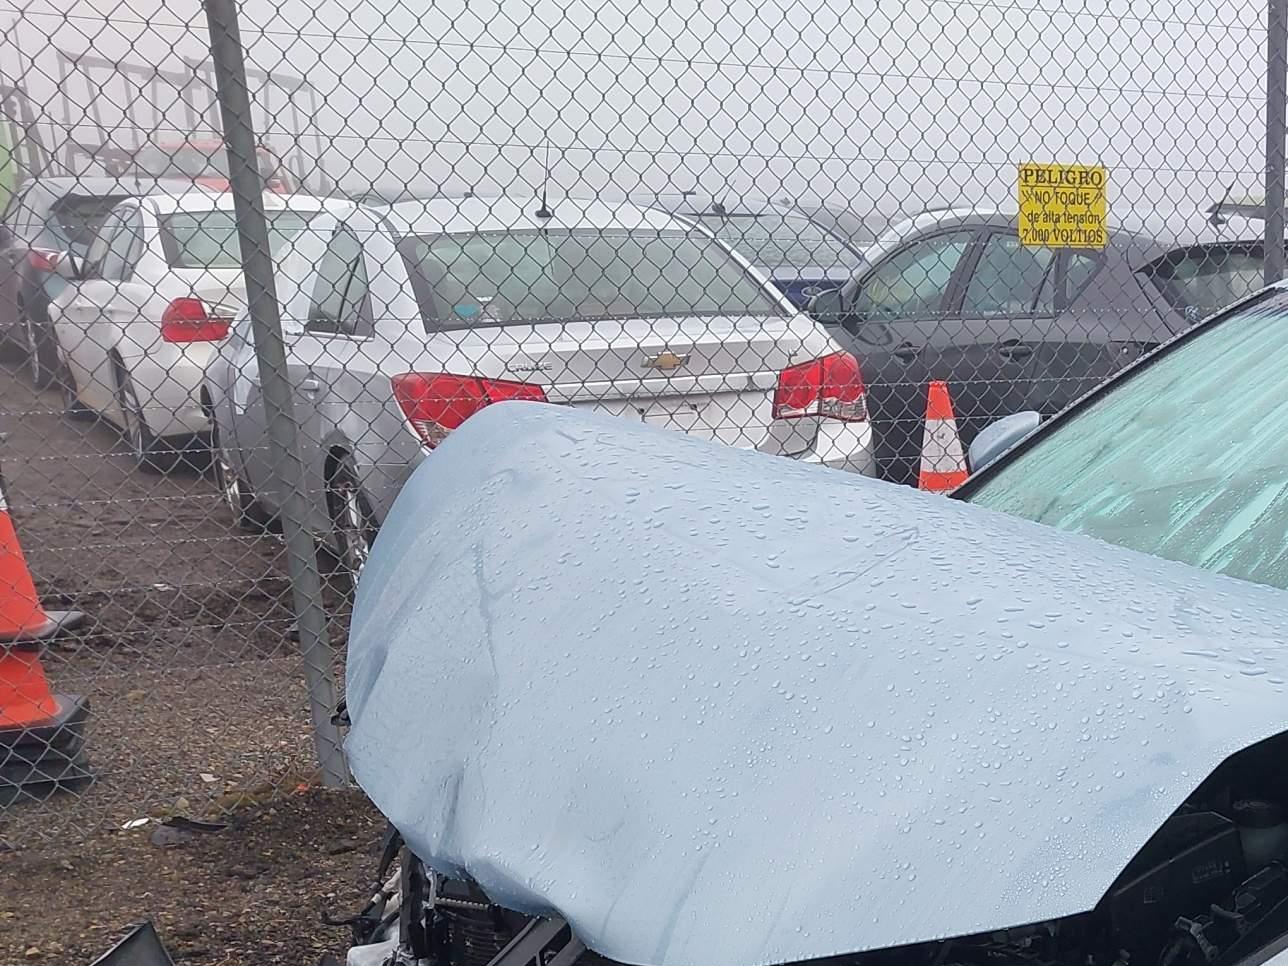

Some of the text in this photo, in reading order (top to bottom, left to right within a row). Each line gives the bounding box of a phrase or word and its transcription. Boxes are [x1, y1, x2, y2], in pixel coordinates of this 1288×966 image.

[1023, 168, 1102, 186] PELIGRO
[1035, 191, 1050, 205] NO
[1027, 210, 1039, 223] de
[1042, 211, 1060, 224] alta
[1023, 228, 1103, 244] 7,000 VOLTIOS
